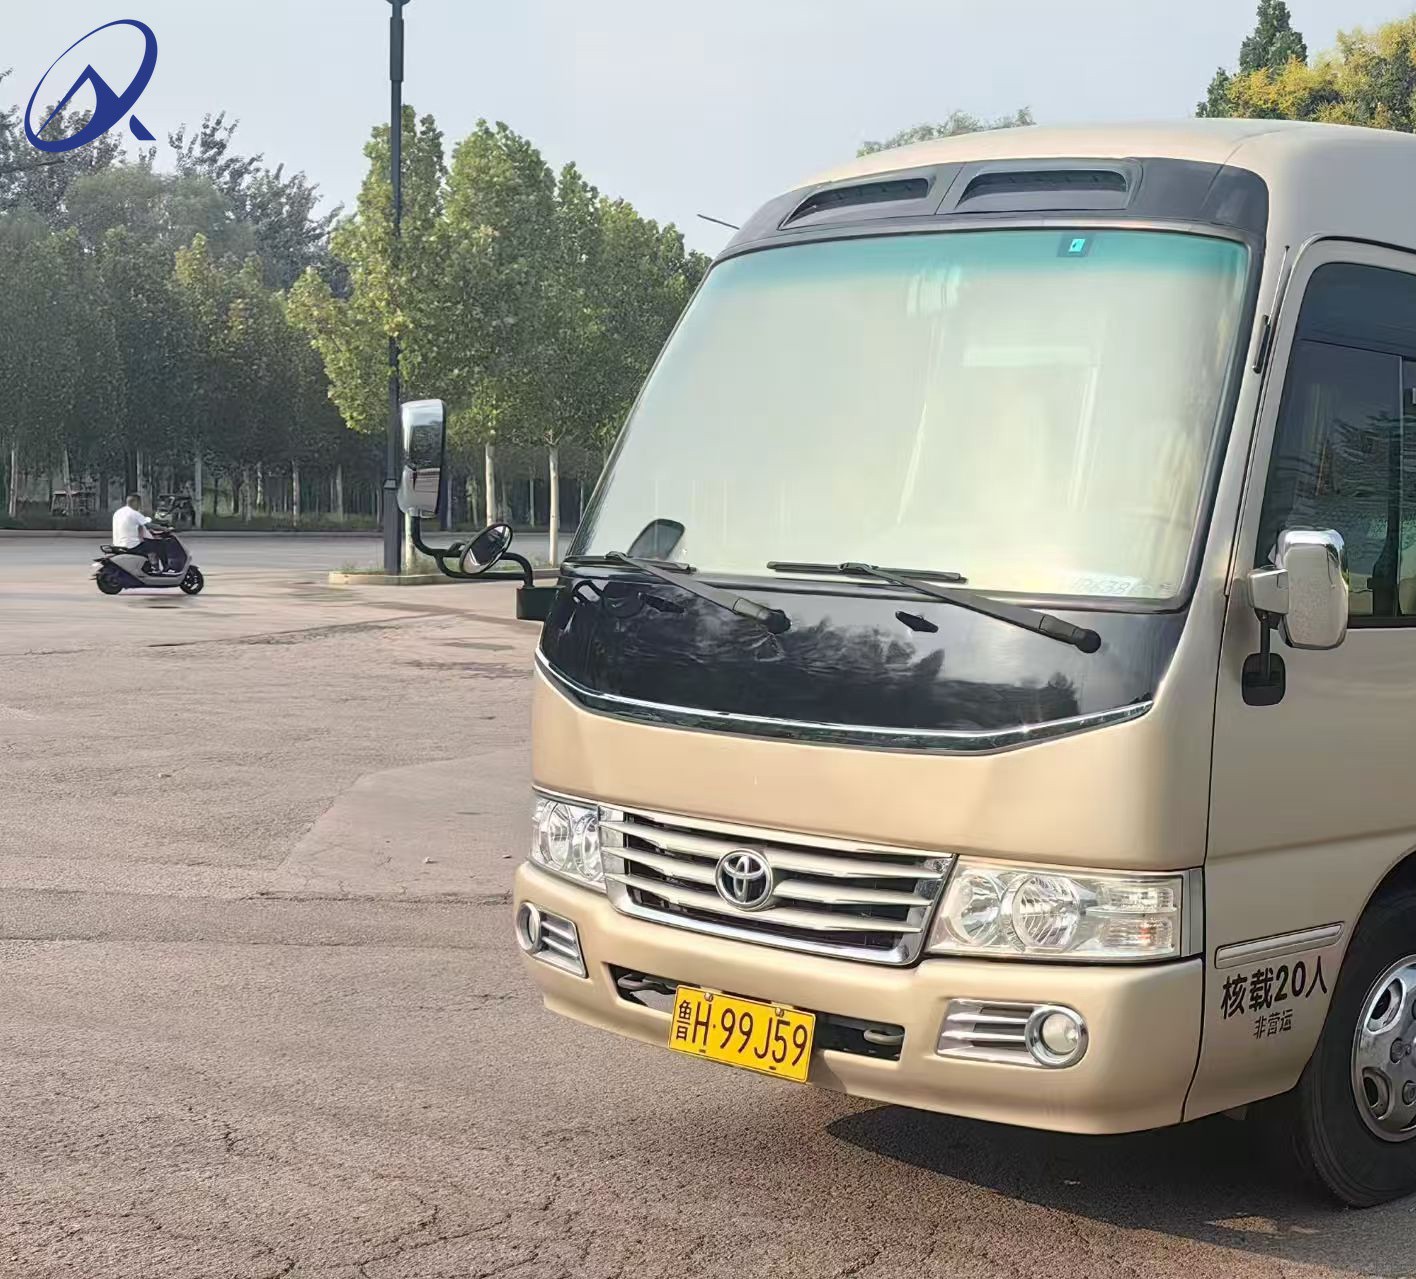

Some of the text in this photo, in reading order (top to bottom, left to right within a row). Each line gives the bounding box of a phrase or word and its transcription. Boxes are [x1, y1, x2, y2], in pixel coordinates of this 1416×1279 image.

[1220, 955, 1328, 1020] 核载20人
[1253, 1008, 1294, 1039] 非营运
